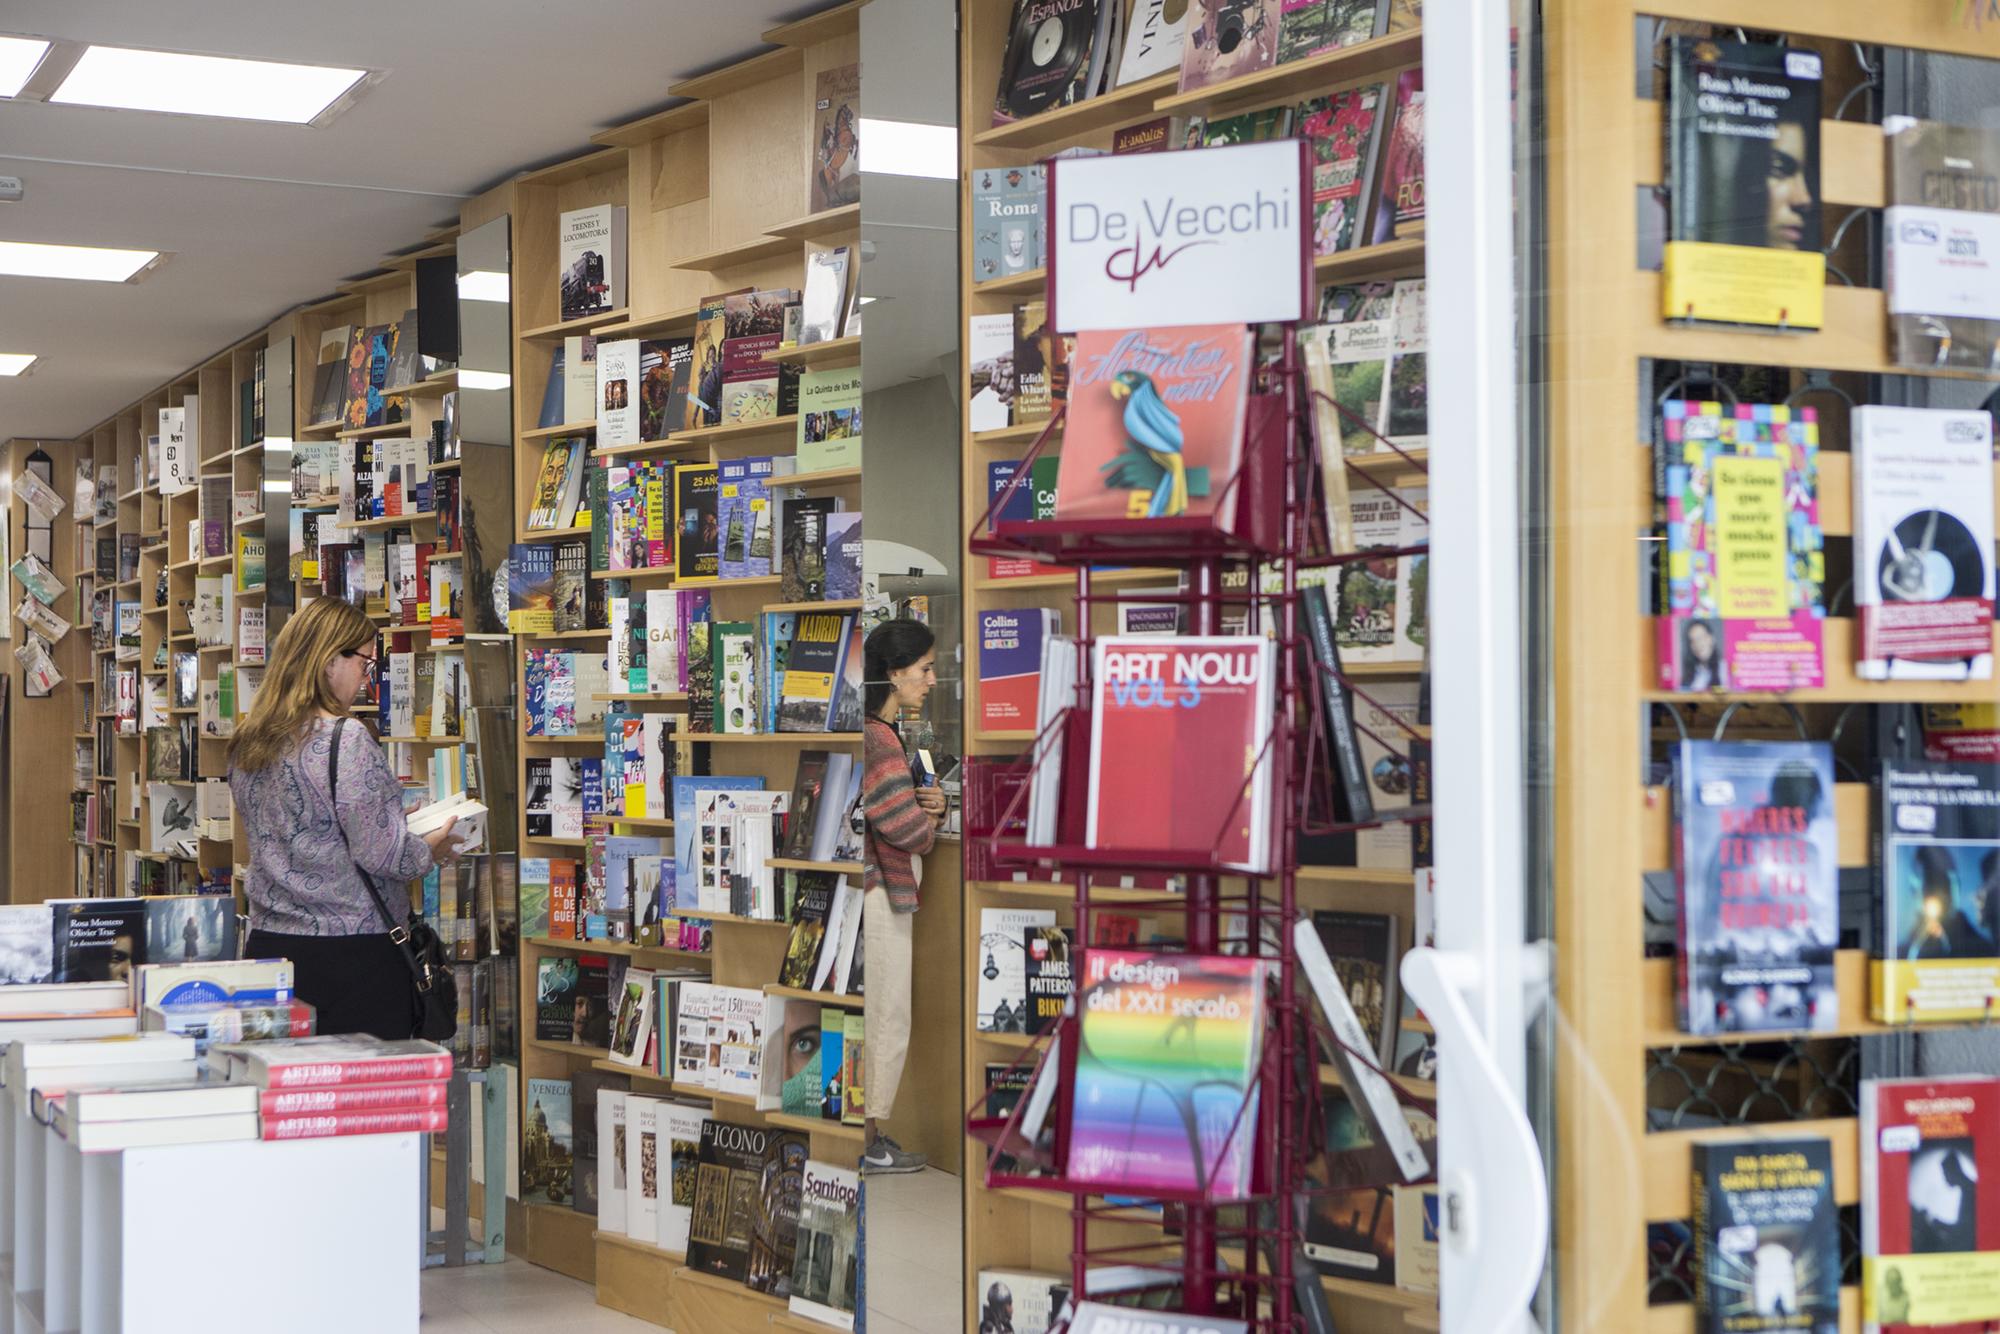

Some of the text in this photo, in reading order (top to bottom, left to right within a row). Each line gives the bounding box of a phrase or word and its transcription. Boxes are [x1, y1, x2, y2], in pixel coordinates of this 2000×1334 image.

[990, 200, 1038, 216] Roma
[1069, 188, 1290, 243] De Vecchi
[572, 222, 594, 231] TRENES
[564, 228, 608, 242] LOCOMOTORAS
[1349, 323, 1379, 338] poda
[1020, 373, 1045, 385] Edith
[815, 385, 832, 394] Quinta
[834, 384, 841, 392] de
[841, 382, 850, 390] los
[994, 466, 1014, 474] Collins
[693, 477, 703, 487] 25
[1721, 473, 1738, 485] Se
[1126, 490, 1152, 519] 5
[1738, 492, 1762, 505] que
[529, 508, 557, 526] WILL
[243, 546, 264, 556] AHO
[528, 551, 553, 561] BRAN
[984, 616, 1018, 628] Collins
[797, 615, 842, 643] MADRID
[984, 628, 1018, 638] first time
[1104, 652, 1259, 685] ART NOW
[1111, 679, 1201, 708] VOL 3
[553, 886, 564, 897] EL
[563, 899, 575, 910] DE
[70, 917, 124, 928] Rosa Montero
[70, 927, 116, 937] Olivier Truc
[69, 938, 117, 947] La desconocida
[1038, 960, 1070, 978] JAMES
[1091, 958, 1179, 989] Il design
[728, 997, 742, 1012] 150
[1087, 989, 1241, 1020] del XXI secolo
[281, 1064, 342, 1078] ARTURO
[533, 1084, 573, 1096] VENECIA
[275, 1091, 336, 1106] ARTURO
[277, 1116, 337, 1131] ARTURO
[703, 1122, 766, 1154] EL ICONO
